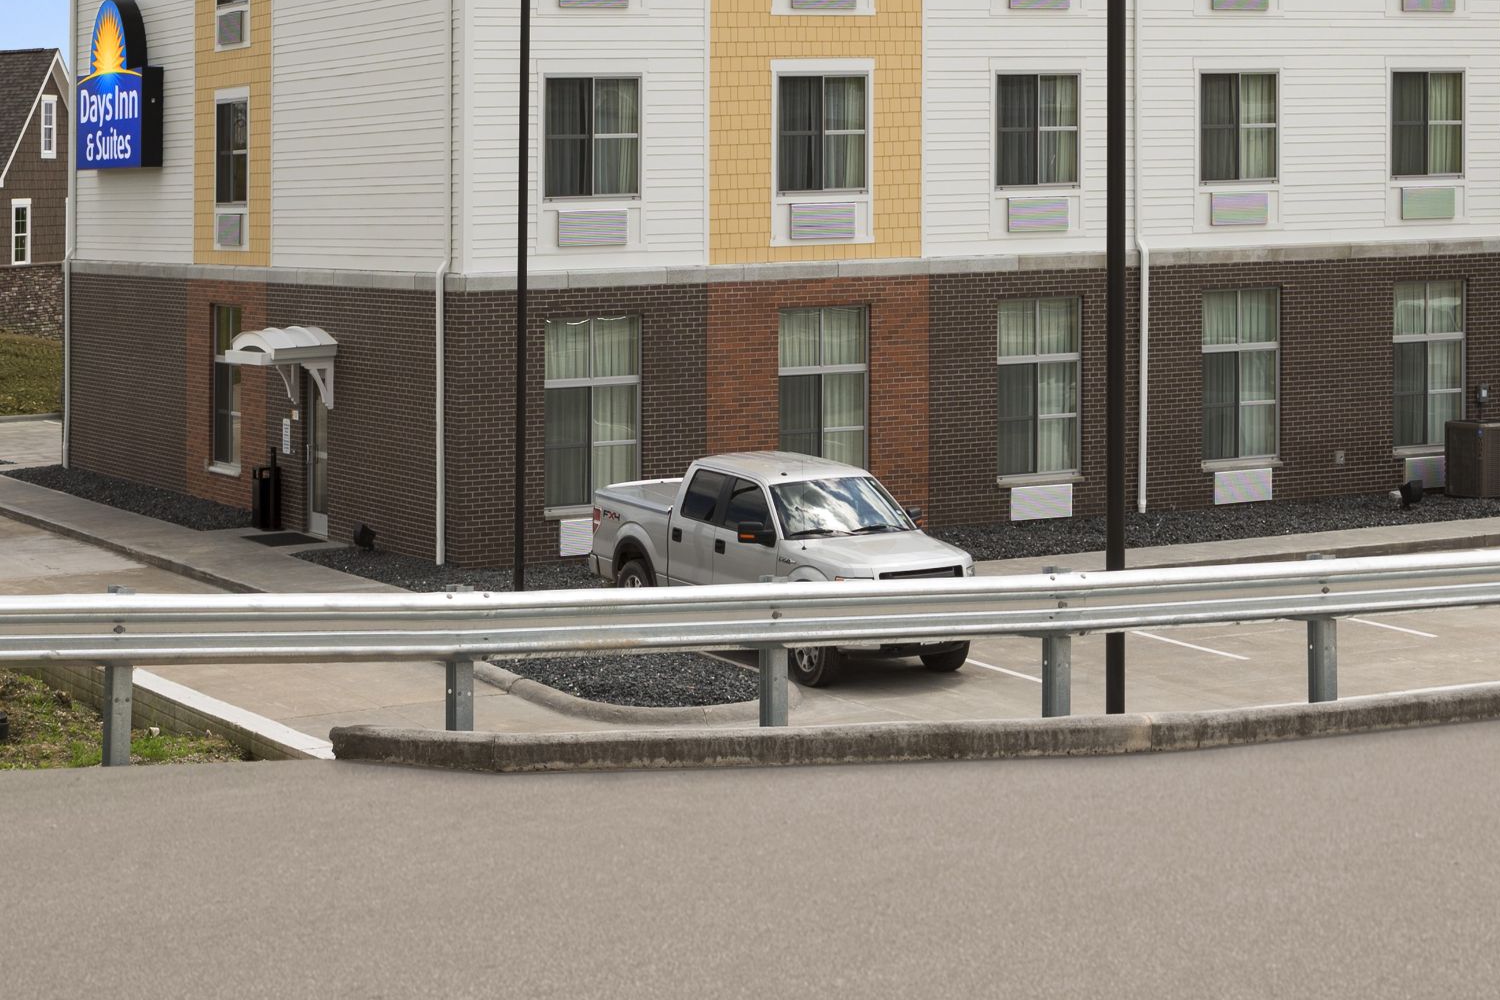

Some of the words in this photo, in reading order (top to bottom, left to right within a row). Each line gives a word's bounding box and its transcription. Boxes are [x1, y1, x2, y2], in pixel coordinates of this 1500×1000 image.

[80, 89, 113, 127] Days
[115, 85, 138, 120] Inn
[86, 133, 94, 161] &
[96, 127, 131, 160] Suites
[602, 509, 621, 521] FX4
